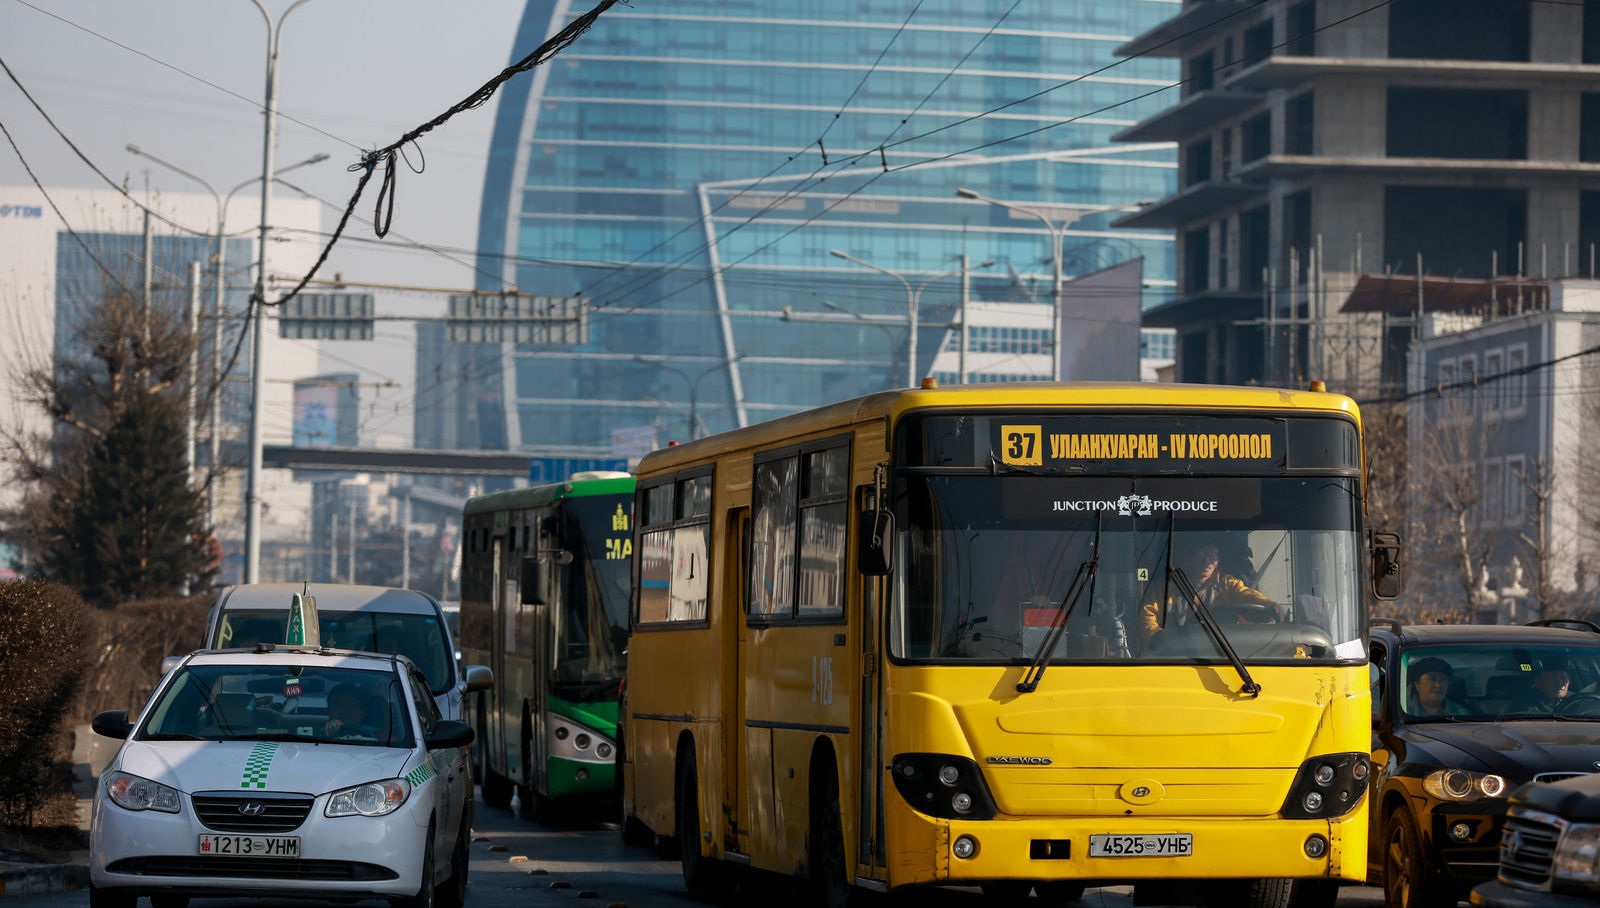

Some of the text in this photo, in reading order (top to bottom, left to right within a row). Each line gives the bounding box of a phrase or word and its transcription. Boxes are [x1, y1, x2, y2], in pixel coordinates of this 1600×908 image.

[1008, 432, 1036, 459] 37
[1050, 433, 1158, 459] УЛААНХУАРАН
[1170, 433, 1186, 459] IV
[1188, 433, 1272, 459] ХОРООЛОЛ
[1052, 500, 1117, 511] JUNCTION
[1153, 500, 1218, 512] PRODUCE
[1139, 569, 1147, 580] 4
[291, 605, 301, 642] TAXI
[986, 755, 1053, 766] DAEWOO
[213, 836, 297, 855] 1213 УНМ
[1103, 837, 1188, 855] 4525 УНБ
